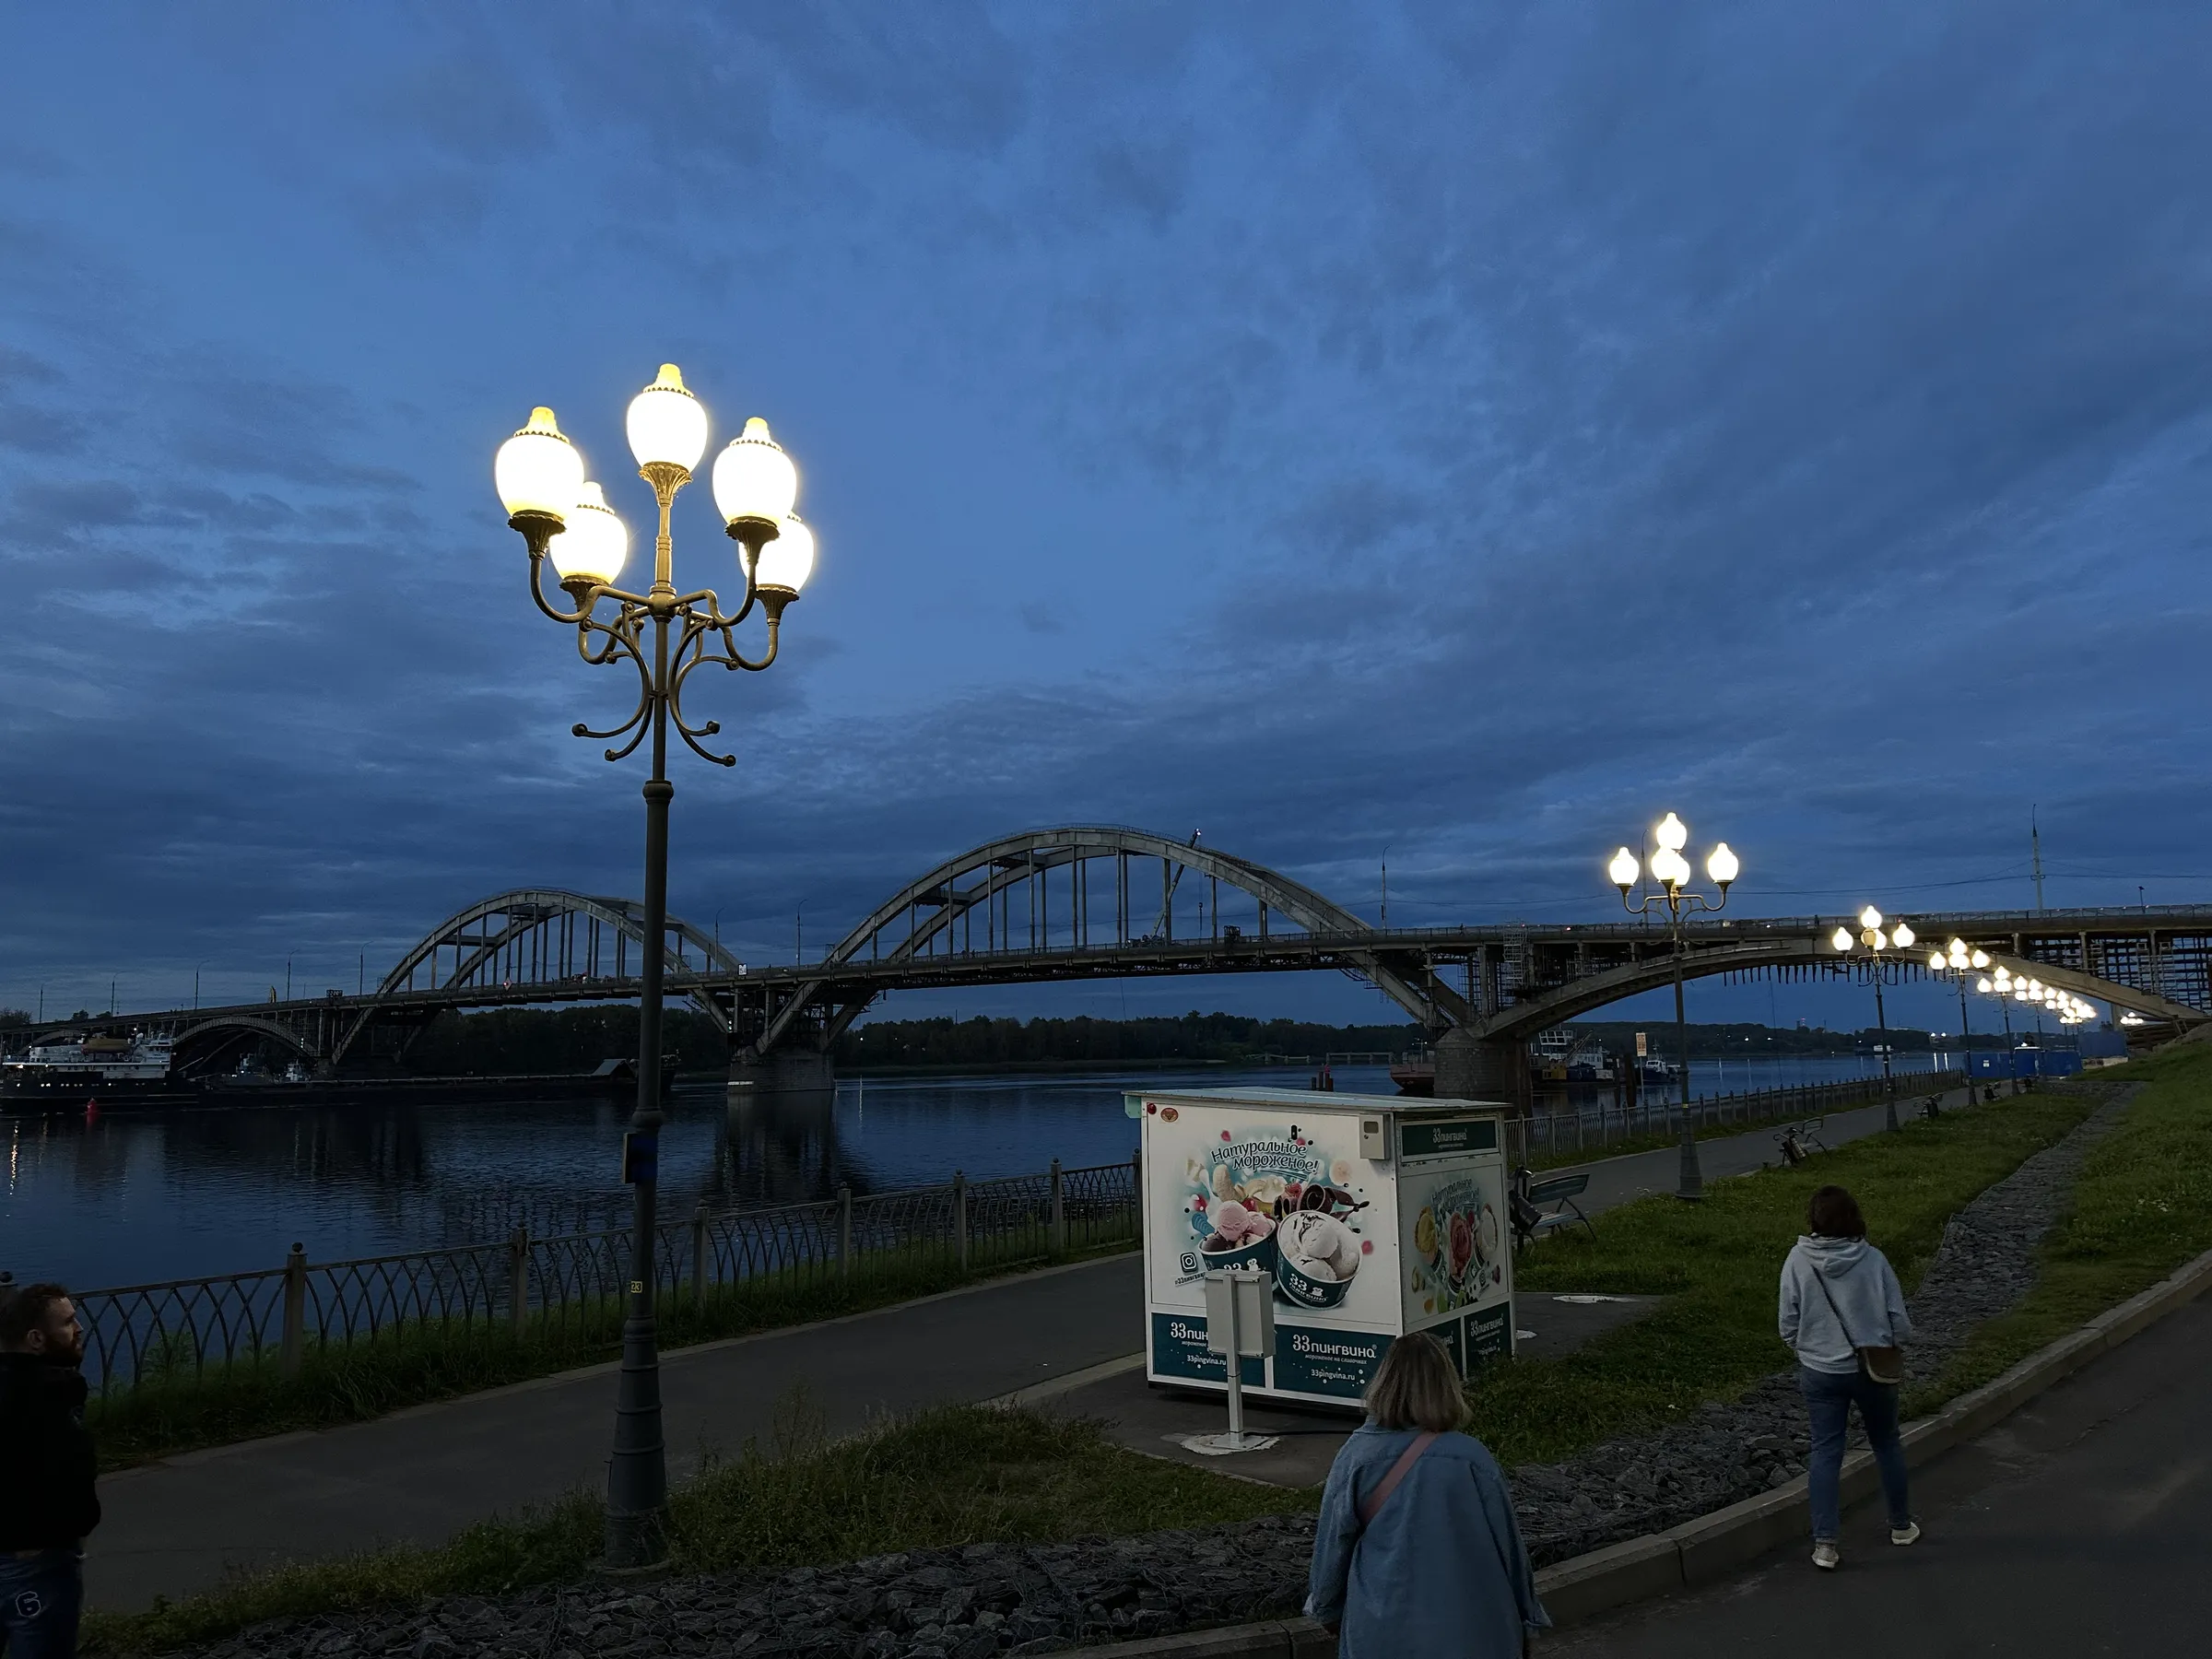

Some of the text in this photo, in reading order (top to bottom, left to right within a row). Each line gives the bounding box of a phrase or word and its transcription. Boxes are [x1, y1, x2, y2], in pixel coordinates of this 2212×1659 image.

[1211, 1141, 1307, 1162] Натуральное
[1233, 1155, 1319, 1173] мороженое!
[631, 1282, 641, 1292] 23
[1289, 1273, 1308, 1291] 33
[1170, 1322, 1208, 1340] 33пин
[1292, 1334, 1377, 1359] 33пингвина
[1311, 1368, 1356, 1381] 33pingvina.ru
[15, 1590, 41, 1618] 6
